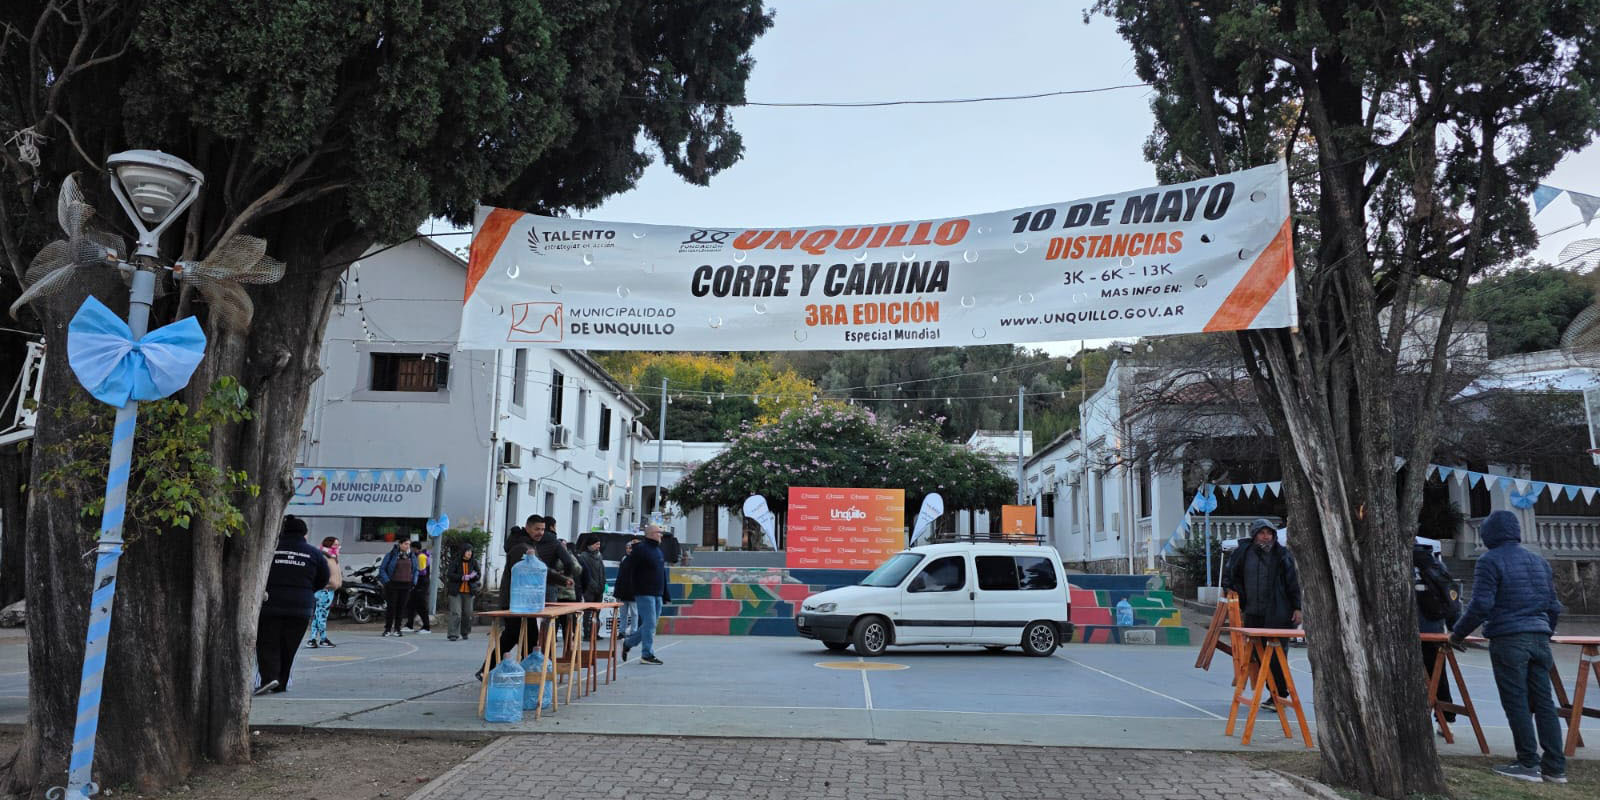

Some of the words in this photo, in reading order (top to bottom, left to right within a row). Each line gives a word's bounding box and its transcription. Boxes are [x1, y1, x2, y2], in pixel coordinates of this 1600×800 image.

[1011, 208, 1057, 234] 10
[1063, 199, 1115, 229] DE
[1120, 181, 1236, 225] MAYO
[542, 230, 616, 242] TALENTO
[732, 218, 971, 255] UNQUILLO
[1045, 231, 1184, 261] DISTANCIAS
[691, 264, 794, 297] CORRE
[800, 263, 821, 297] Y
[823, 260, 950, 297] CAMINA
[1063, 270, 1085, 285] 3K
[1101, 268, 1124, 282] 6K
[1143, 263, 1173, 277] 13K
[1101, 288, 1129, 298] MAS
[1132, 286, 1161, 296] INFO
[1163, 284, 1183, 294] EN:
[570, 307, 676, 319] MUNICIPALIDAD
[805, 303, 848, 326] 3RA
[853, 297, 940, 325] EDICIÓN
[571, 323, 591, 335] DE
[594, 322, 675, 336] UNQUILLO
[845, 329, 891, 343] Especial
[895, 327, 940, 340] Mundial
[331, 482, 422, 493] MUNICIPALIDAD
[330, 493, 345, 502] DE
[347, 493, 403, 503] UNQUILLO
[830, 505, 867, 521] Unquillo
